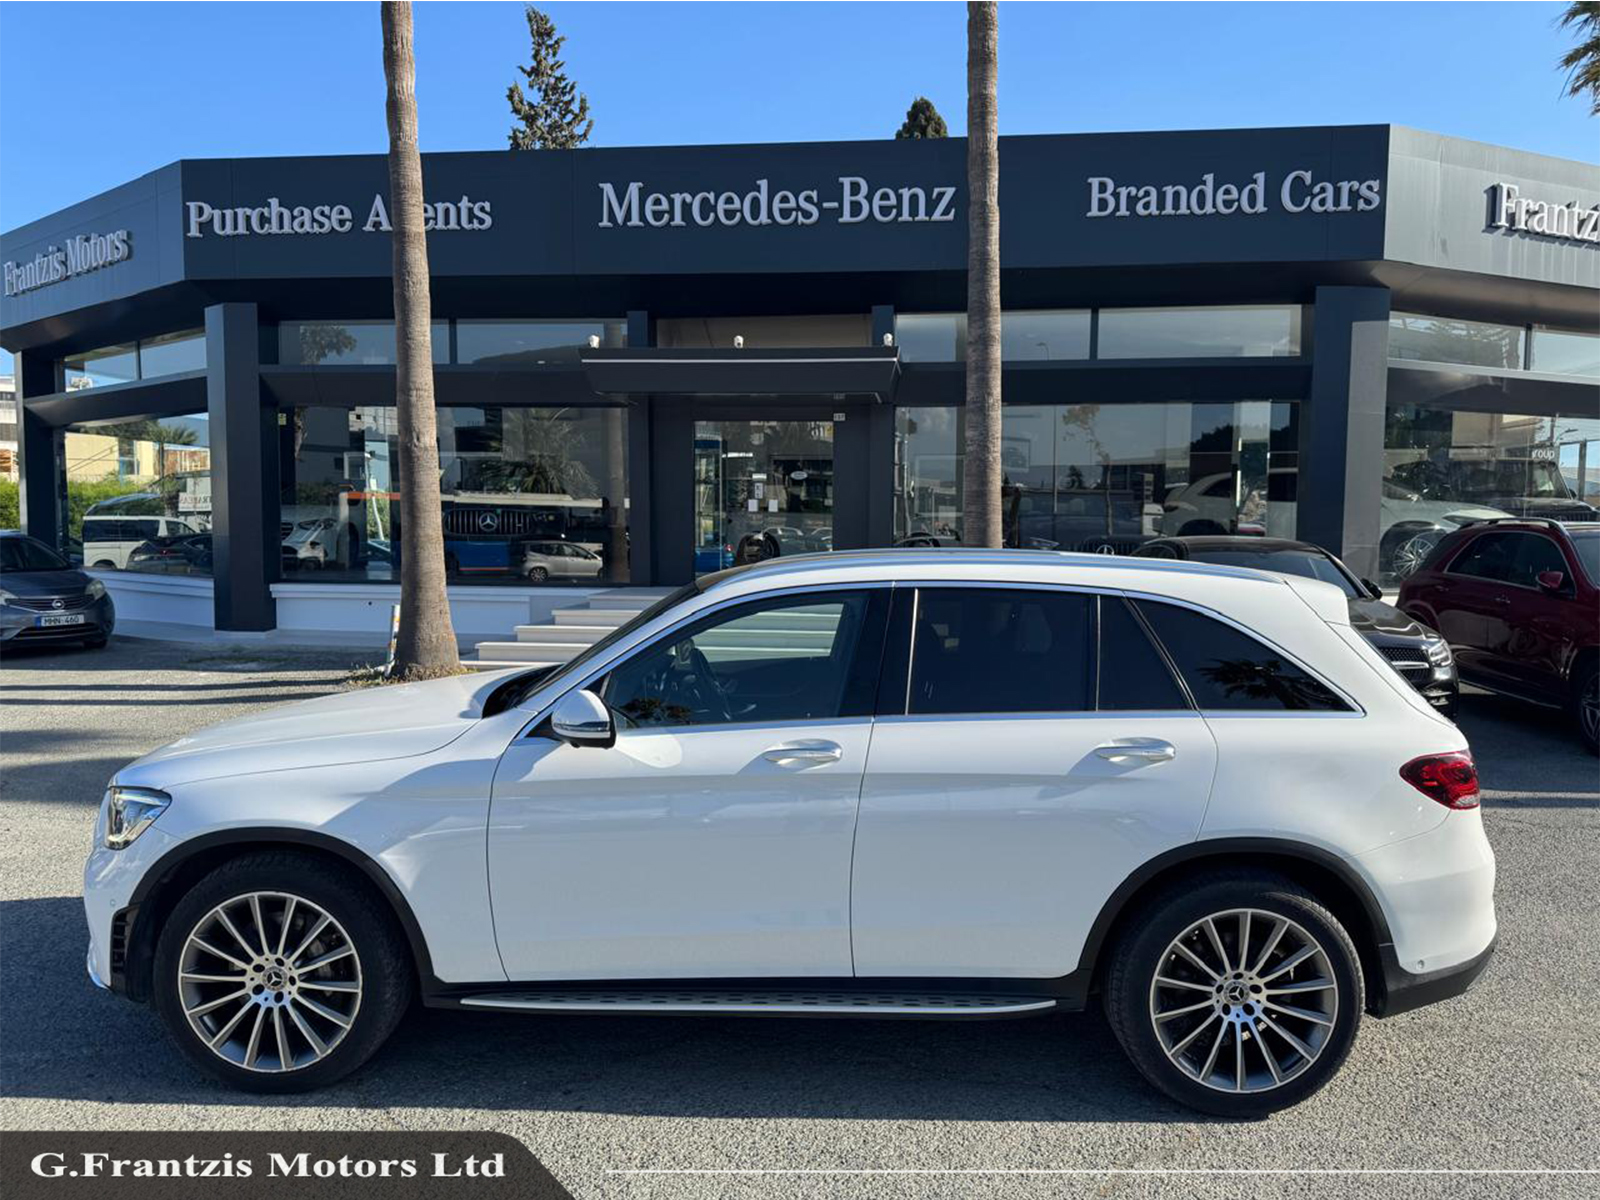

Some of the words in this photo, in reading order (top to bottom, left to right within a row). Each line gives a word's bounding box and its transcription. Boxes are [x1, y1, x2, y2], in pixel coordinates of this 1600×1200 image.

[185, 197, 353, 238] Purchase
[362, 193, 492, 232] Aents
[598, 176, 956, 228] Mercedes-Benz
[1085, 172, 1268, 217] Branded
[1280, 170, 1381, 213] Cars
[3, 246, 66, 297] Frantzis
[65, 230, 128, 275] Motors
